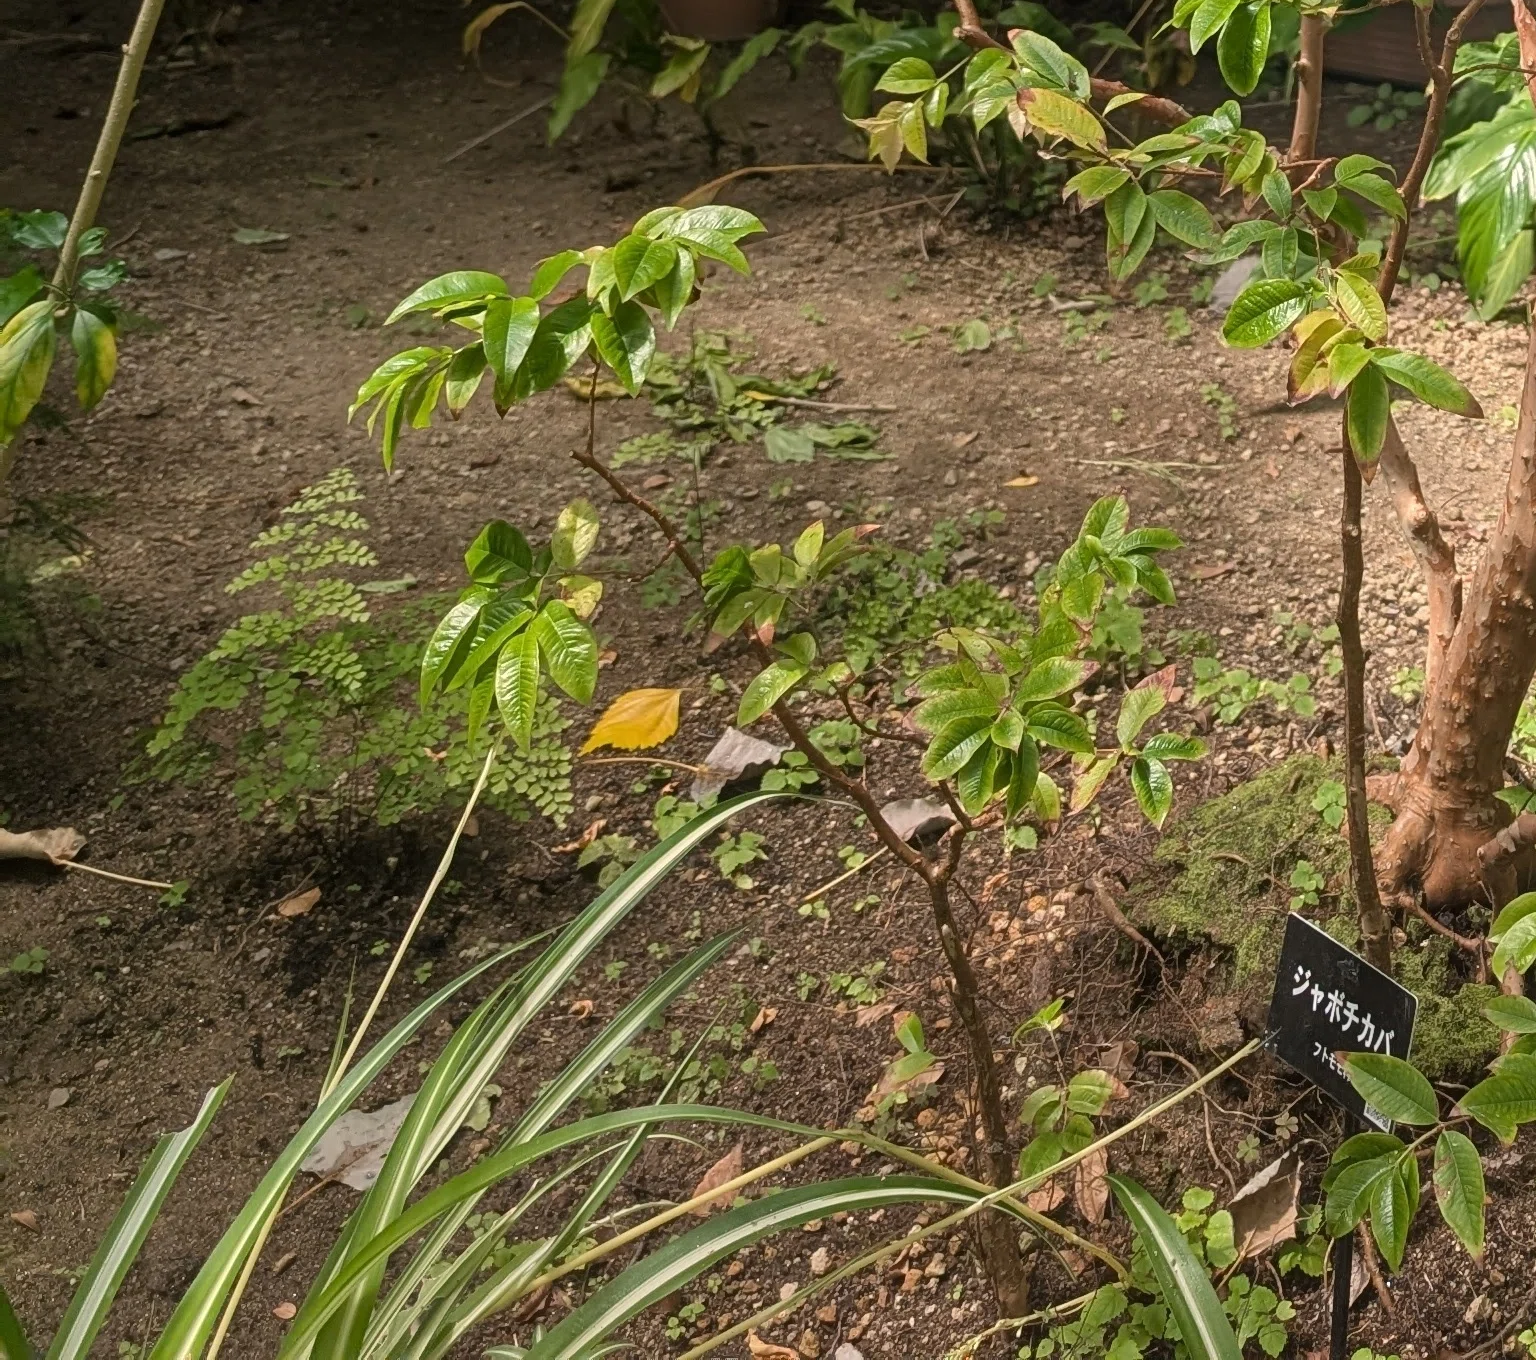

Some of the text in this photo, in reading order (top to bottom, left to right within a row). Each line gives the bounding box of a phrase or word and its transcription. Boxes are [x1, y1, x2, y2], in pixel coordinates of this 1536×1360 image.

[1292, 965, 1396, 1057] ジャボチカバ
